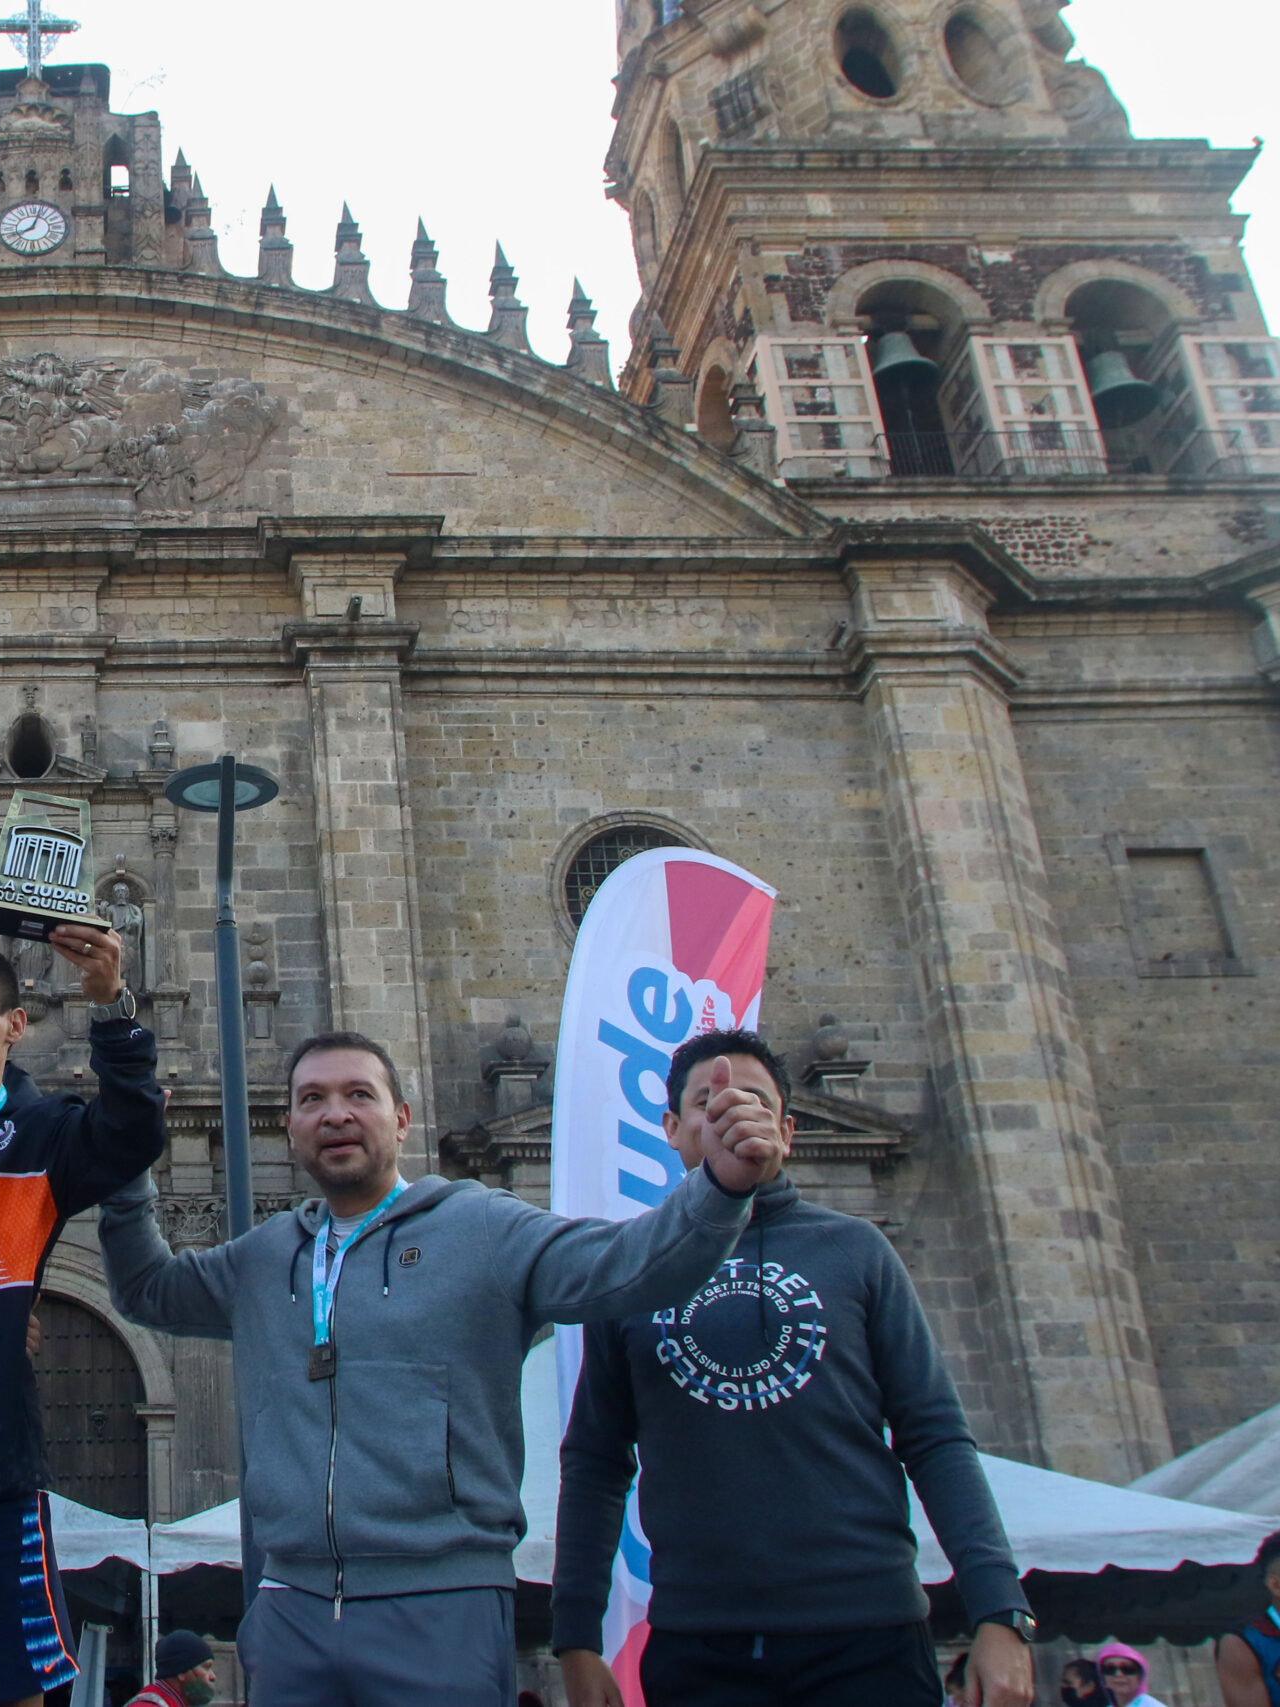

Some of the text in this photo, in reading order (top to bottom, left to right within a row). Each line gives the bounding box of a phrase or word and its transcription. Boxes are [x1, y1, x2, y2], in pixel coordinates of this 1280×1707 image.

[22, 882, 90, 904] CIUDAD
[28, 895, 88, 914] QUIERO
[681, 1299, 704, 1325] DON'T
[704, 1282, 729, 1297] GET
[732, 1281, 744, 1289] IT
[756, 1262, 824, 1310] GET
[683, 1325, 793, 1378] DON'T GET IT TWISTED
[796, 1322, 827, 1361] IT
[656, 1338, 812, 1411] TWISTED
